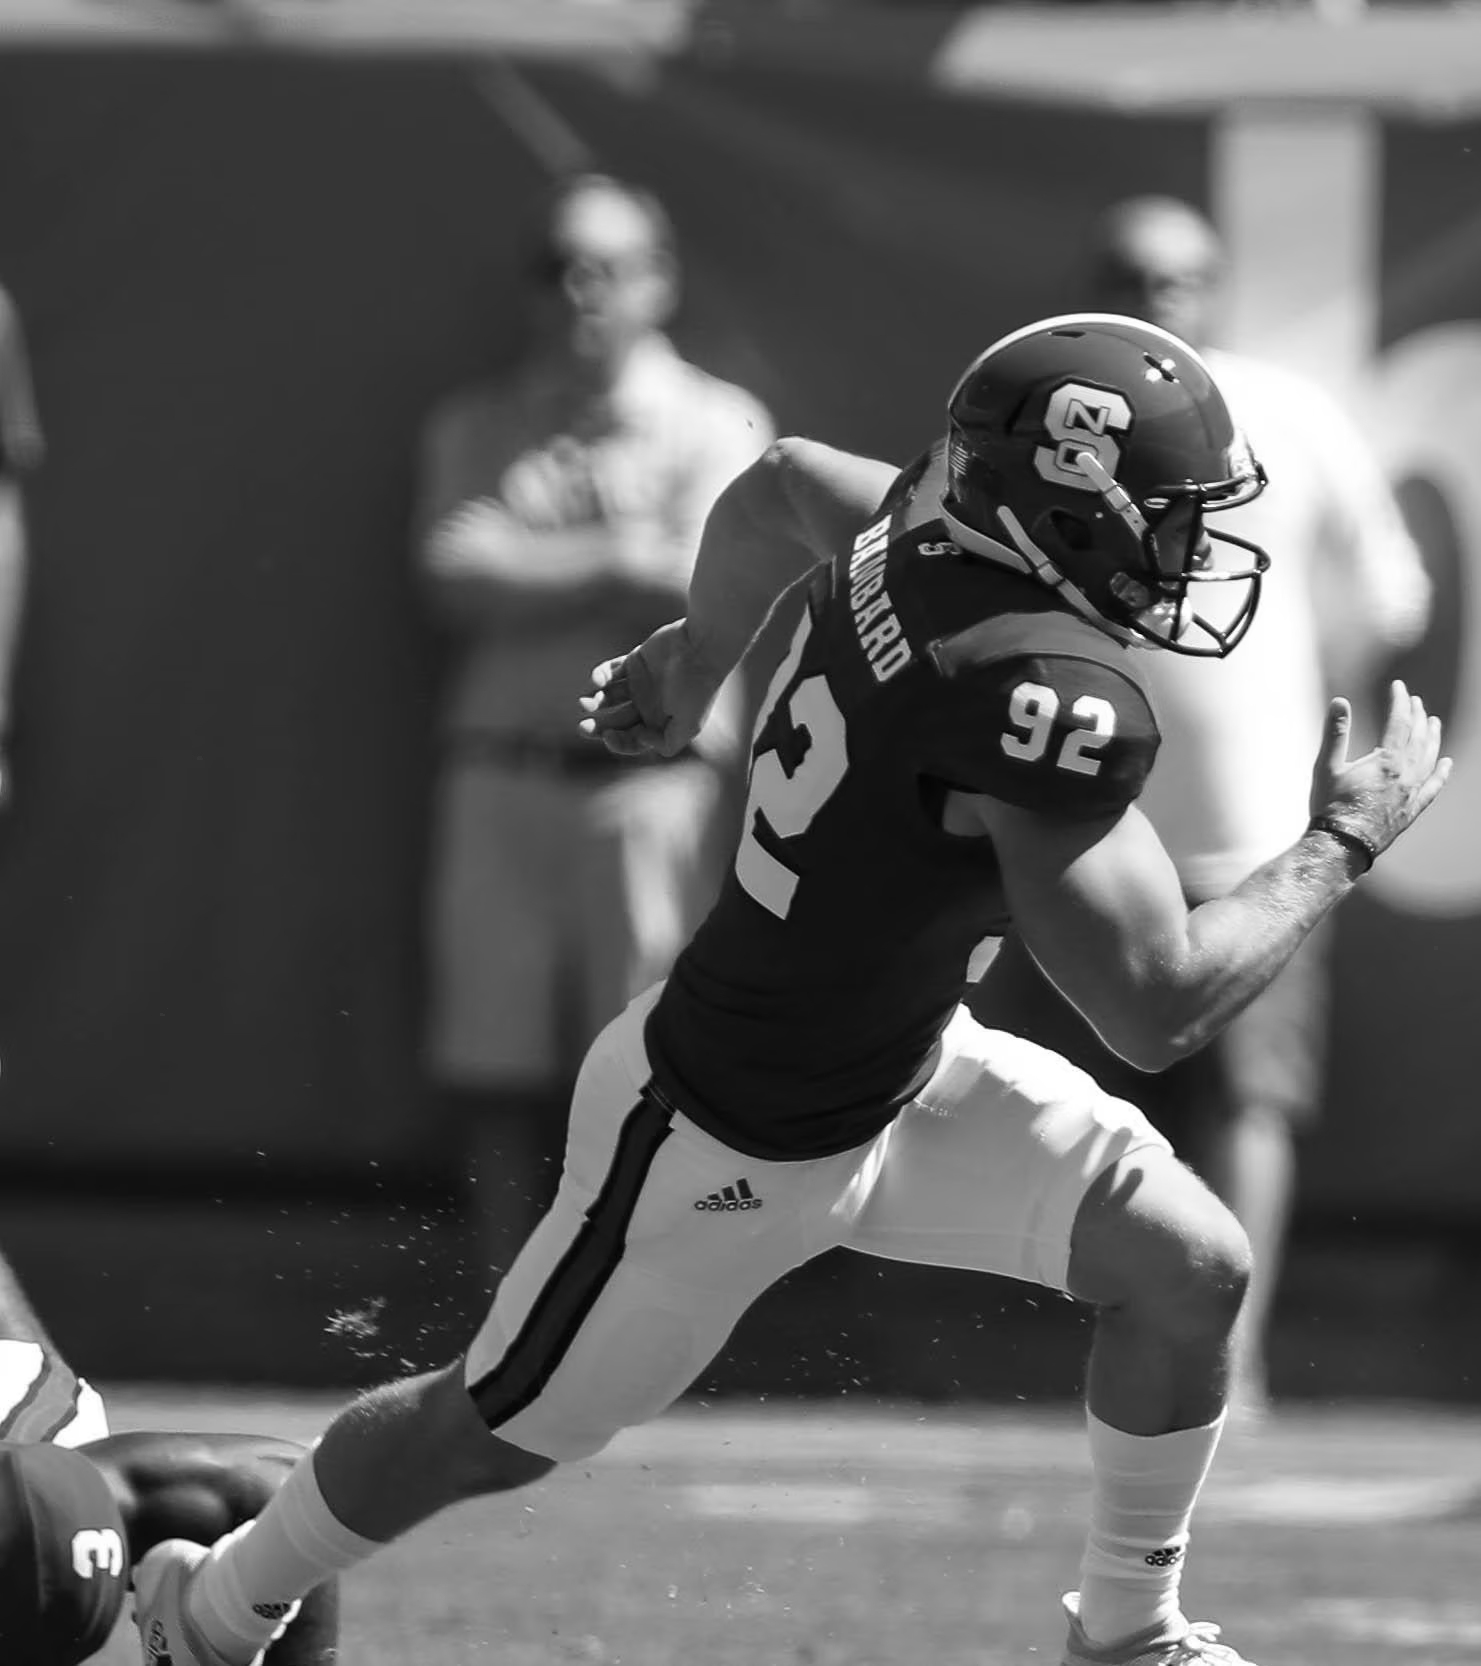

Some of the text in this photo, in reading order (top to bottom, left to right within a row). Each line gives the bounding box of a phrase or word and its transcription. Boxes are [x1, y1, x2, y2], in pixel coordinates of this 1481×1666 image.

[849, 514, 912, 682] BAMBARD
[1000, 682, 1117, 776] 92
[694, 1197, 763, 1212] adidas
